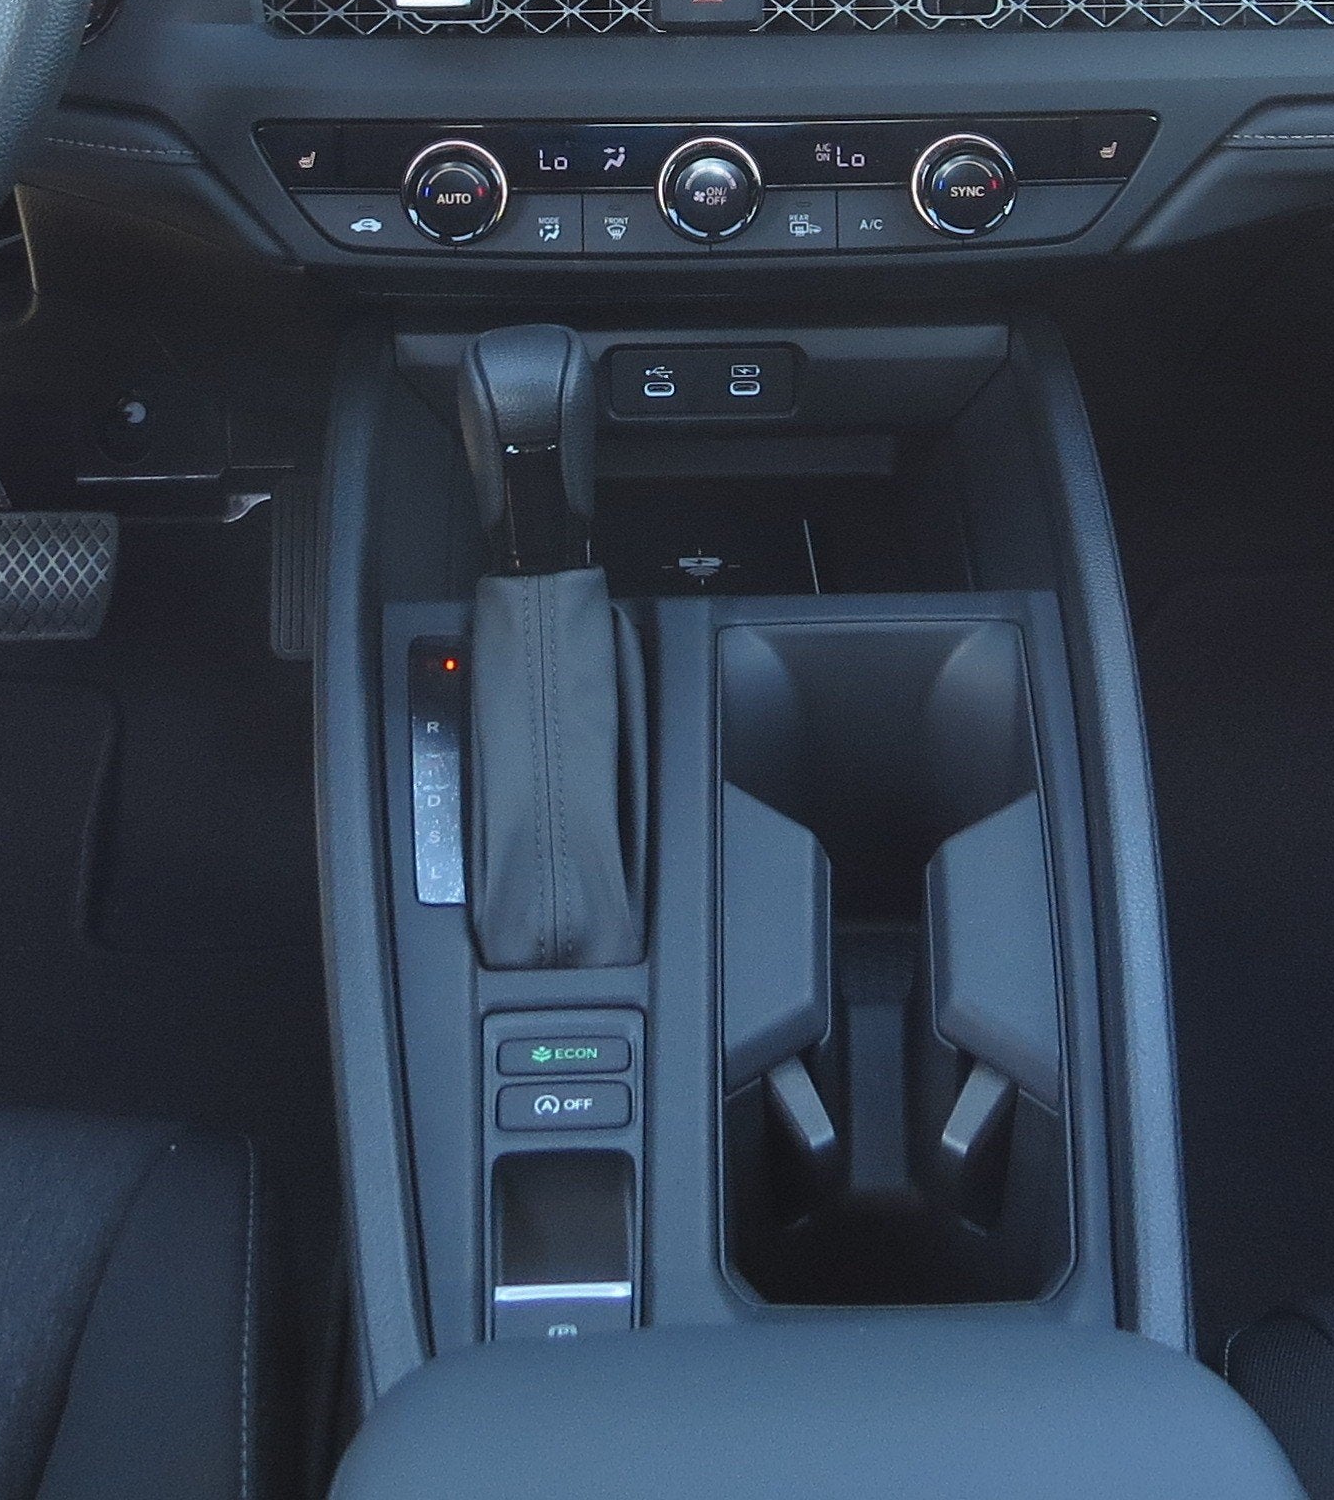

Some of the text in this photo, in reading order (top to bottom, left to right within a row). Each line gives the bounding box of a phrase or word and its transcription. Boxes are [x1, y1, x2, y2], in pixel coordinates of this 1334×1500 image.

[814, 143, 832, 153] A/C
[538, 149, 568, 171] Lo
[816, 153, 830, 162] ON
[836, 145, 865, 167] Lo
[950, 186, 986, 198] SYNC
[436, 192, 472, 205] AUTO
[706, 196, 727, 206] OFF
[538, 217, 560, 225] MODE
[604, 216, 630, 225] FRONT
[788, 214, 810, 222] REAR
[859, 219, 883, 231] A/C
[427, 721, 440, 733] R
[427, 794, 441, 807] D
[428, 830, 441, 843] S
[430, 868, 442, 879] L
[554, 1047, 598, 1059] ECON
[564, 1098, 593, 1111] OFF
